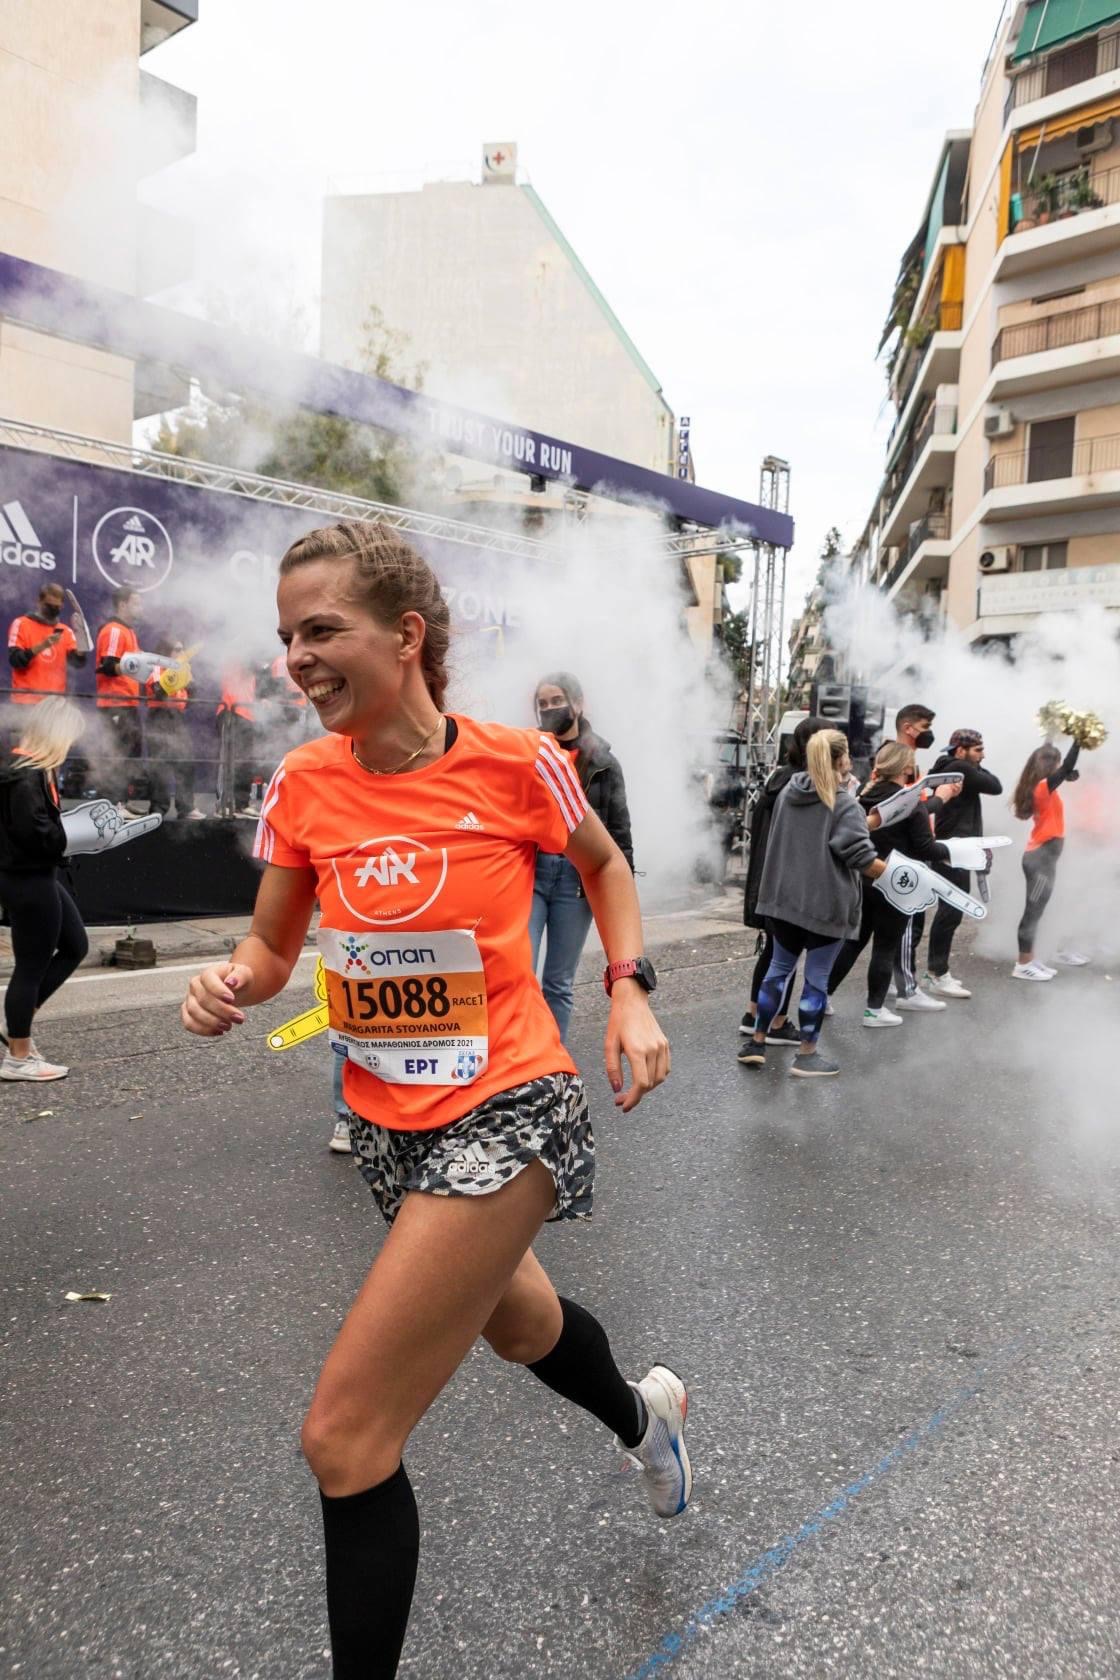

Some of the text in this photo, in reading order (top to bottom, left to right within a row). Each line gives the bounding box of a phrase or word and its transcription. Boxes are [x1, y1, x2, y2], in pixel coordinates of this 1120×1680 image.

[491, 427, 536, 464] YOUR
[540, 442, 572, 474] RUN
[454, 822, 485, 831] adidas
[341, 976, 450, 1021] 15088
[343, 1021, 461, 1034] MARGARITA STOYANOVA
[422, 1039, 456, 1048] ΔΡΟΜΟΣ
[457, 1039, 473, 1047] 2021
[448, 1160, 496, 1174] adidas
